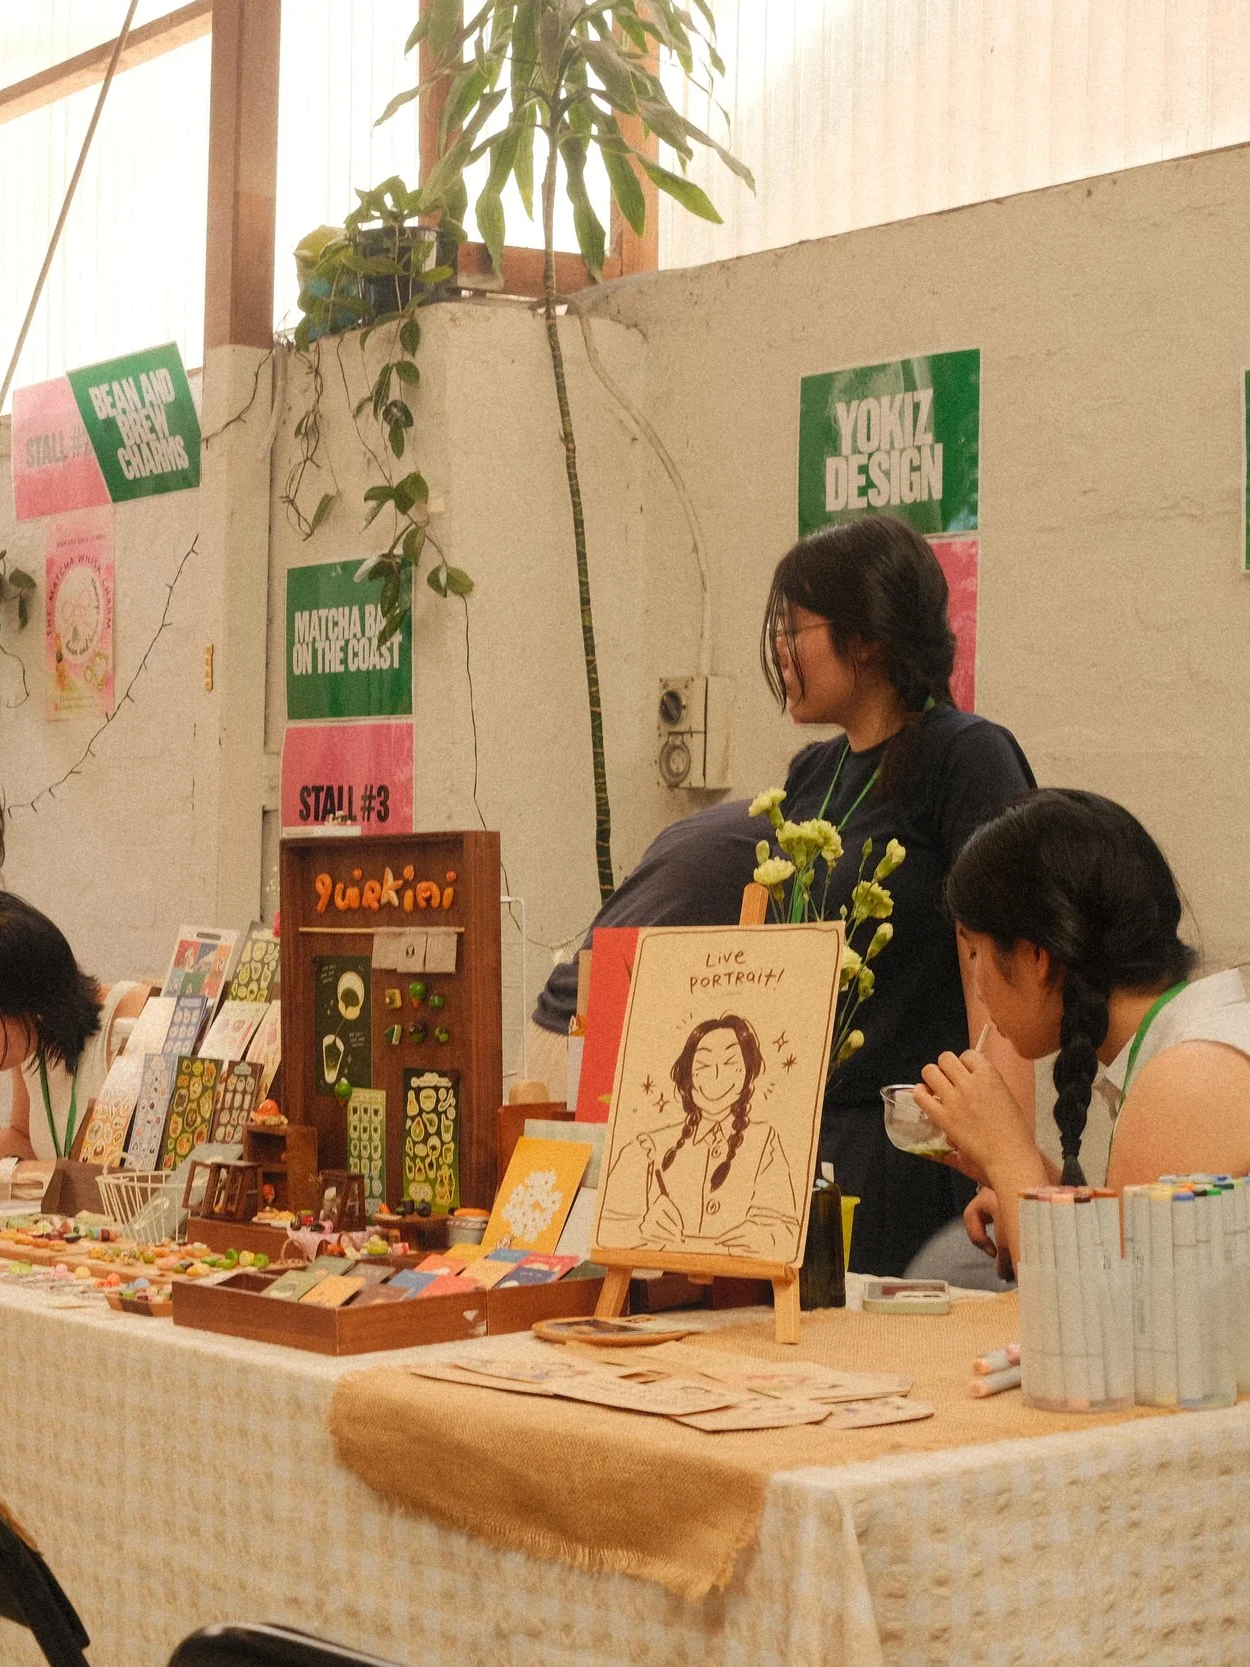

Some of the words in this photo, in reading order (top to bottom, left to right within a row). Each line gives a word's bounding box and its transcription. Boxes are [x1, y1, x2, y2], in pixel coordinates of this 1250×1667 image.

[88, 376, 142, 420] BEAN
[139, 368, 176, 409] AND
[115, 402, 170, 448] BREW
[835, 388, 934, 457] YOKIZ
[26, 431, 68, 469] STALL
[117, 434, 190, 481] CHARMS
[825, 443, 943, 512] DESIGN
[49, 556, 75, 601] MATCHA
[295, 605, 361, 643] MATCHA
[293, 642, 312, 675] ON
[315, 639, 345, 674] THE
[348, 631, 402, 671] COAST
[299, 784, 357, 823] STALL
[361, 784, 390, 823] #3
